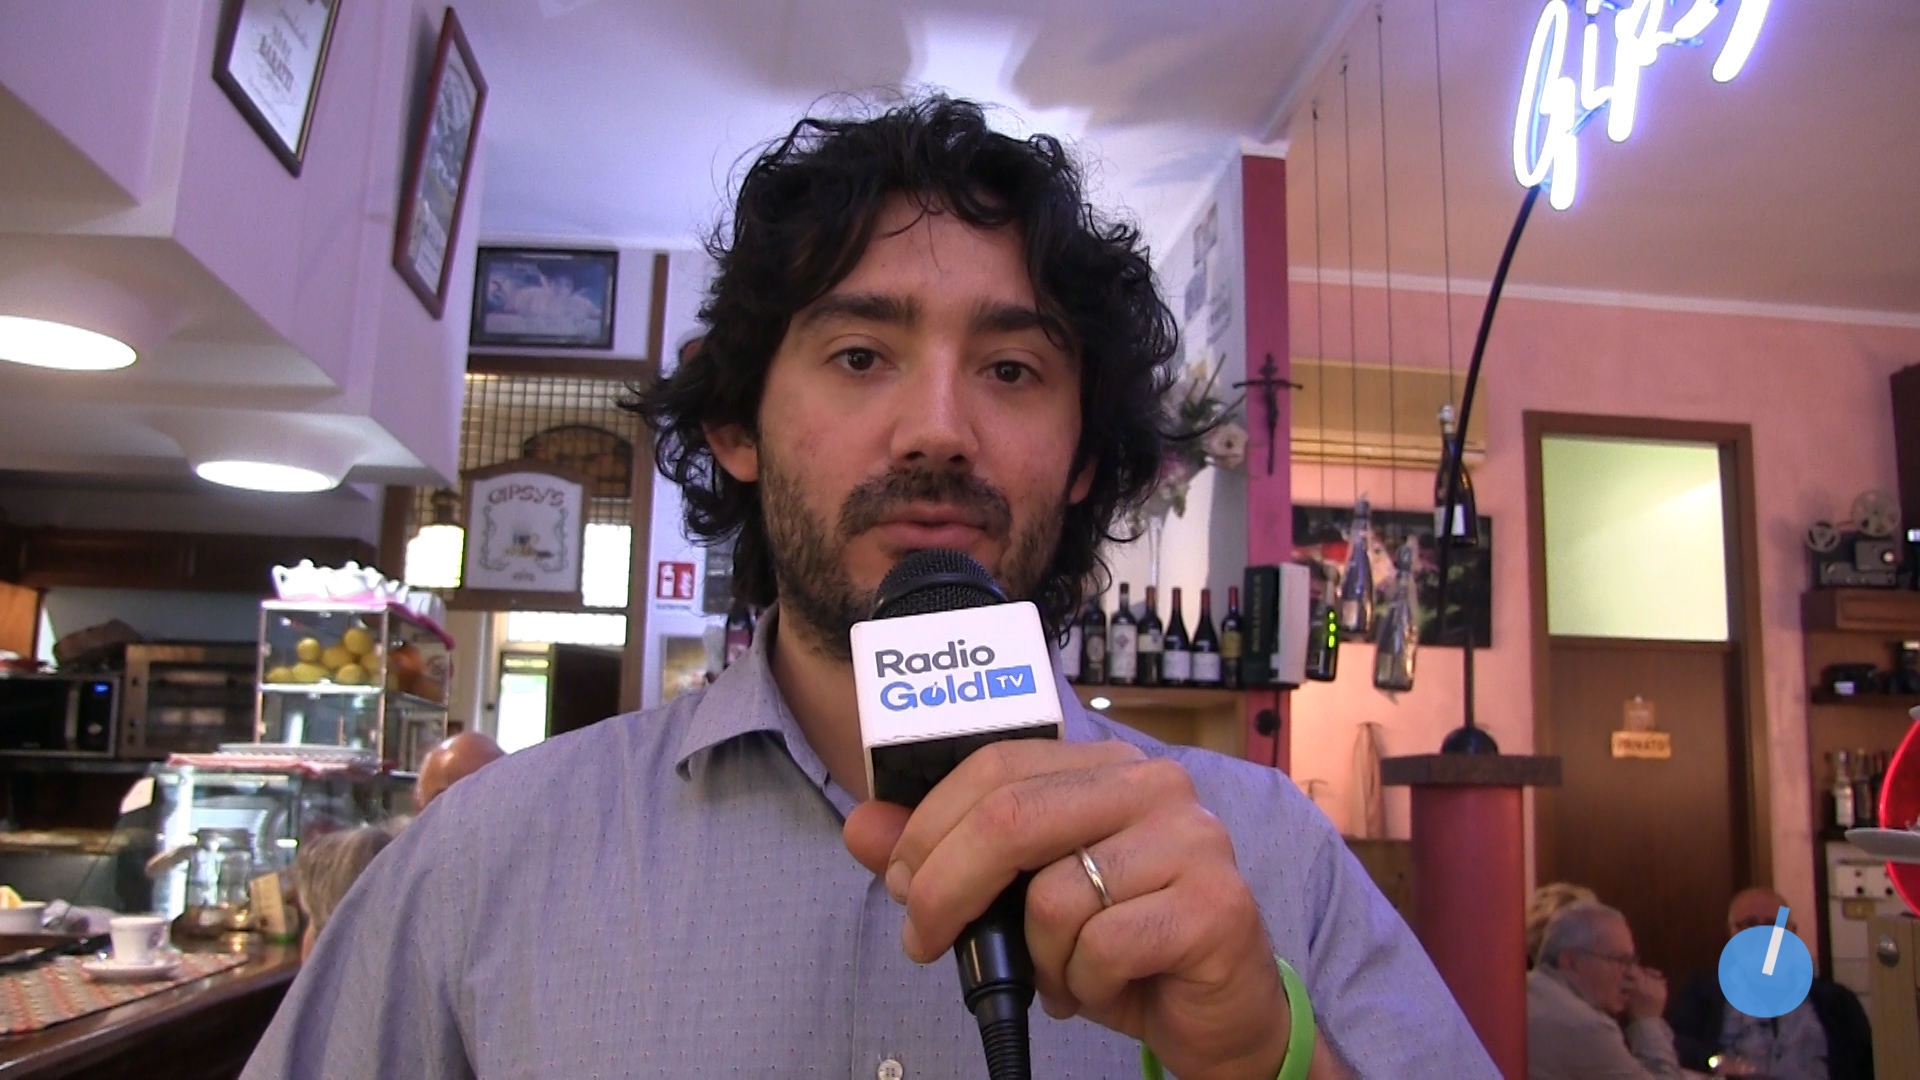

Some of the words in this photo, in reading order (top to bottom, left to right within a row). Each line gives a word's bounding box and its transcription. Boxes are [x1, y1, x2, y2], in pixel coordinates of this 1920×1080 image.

[1513, 0, 1771, 211] Gip
[875, 639, 995, 678] Radio
[880, 671, 986, 711] Gold
[996, 673, 1023, 689] TV
